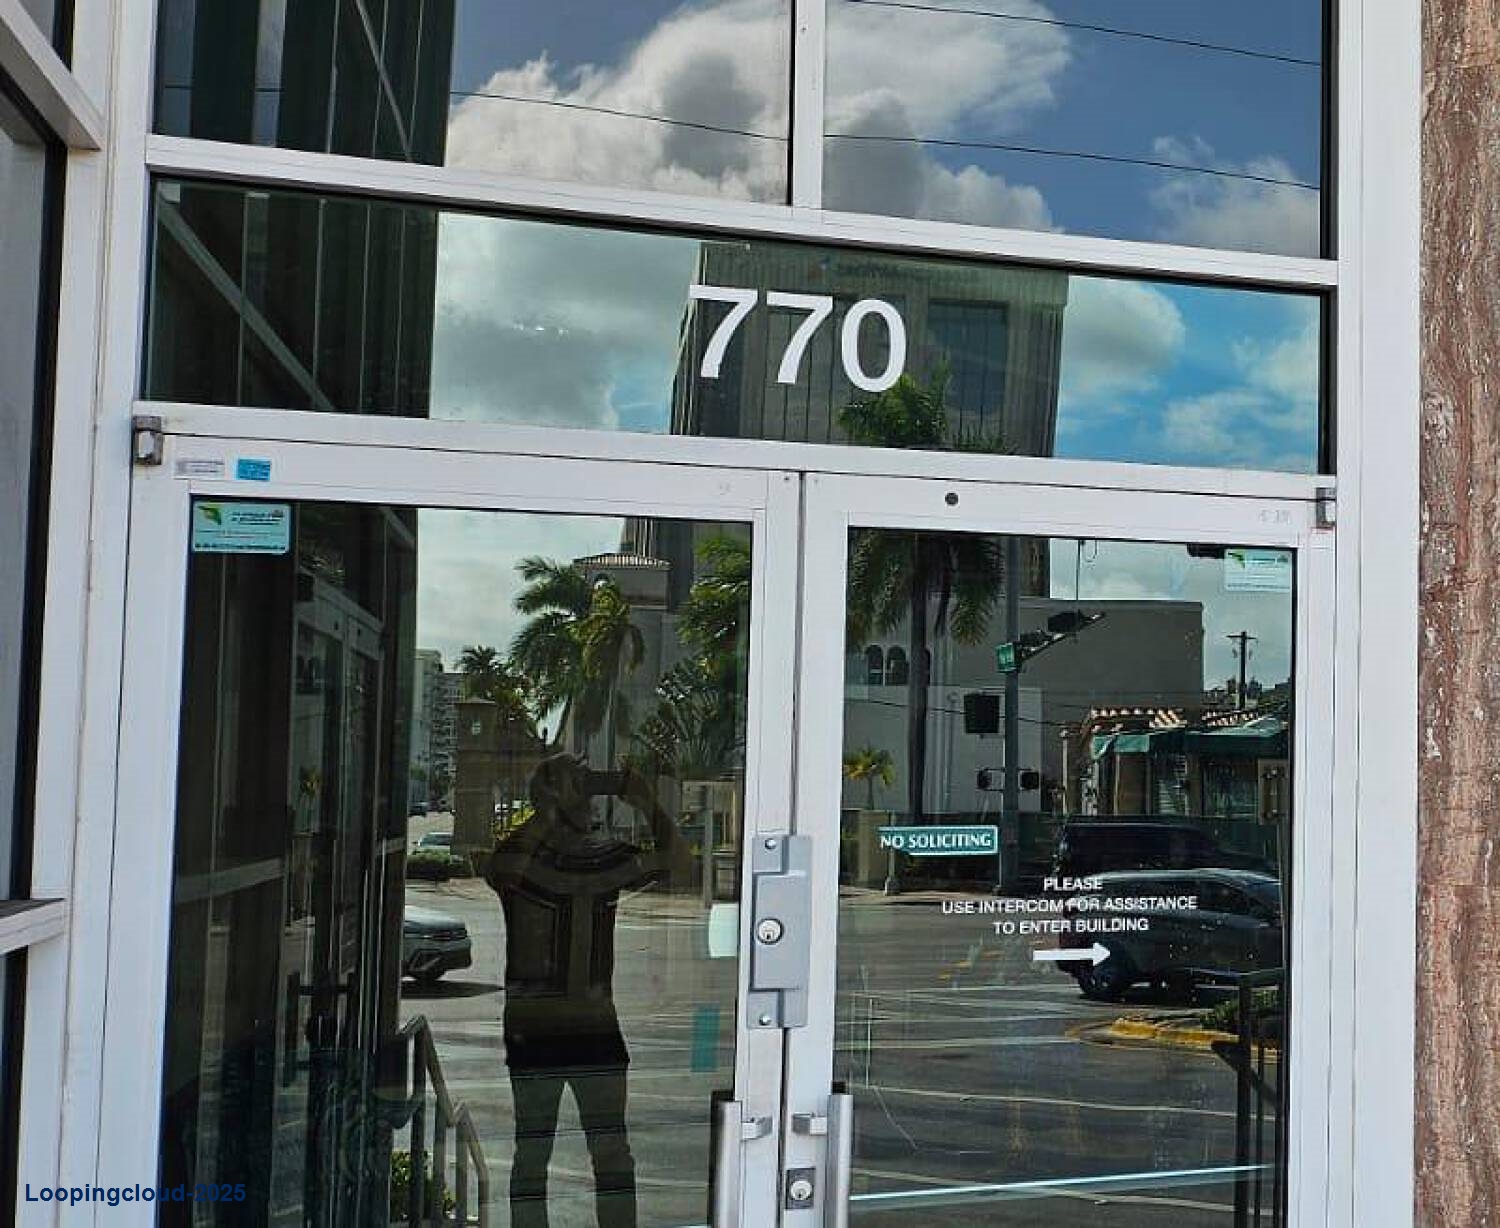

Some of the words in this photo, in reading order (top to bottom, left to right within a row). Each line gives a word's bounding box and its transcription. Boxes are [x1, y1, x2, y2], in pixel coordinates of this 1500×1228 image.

[689, 284, 907, 393] 770
[880, 834, 903, 850] NO
[908, 832, 993, 849] SOLICITING
[1043, 877, 1103, 892] PLEASE
[942, 900, 976, 914] USE
[978, 899, 1064, 914] INTERCOM
[1067, 898, 1100, 912] FOR
[1104, 896, 1198, 911] ASSISTANCE
[993, 921, 1015, 935] TO
[1019, 919, 1071, 935] ENTER
[1075, 918, 1150, 933] BUILDING
